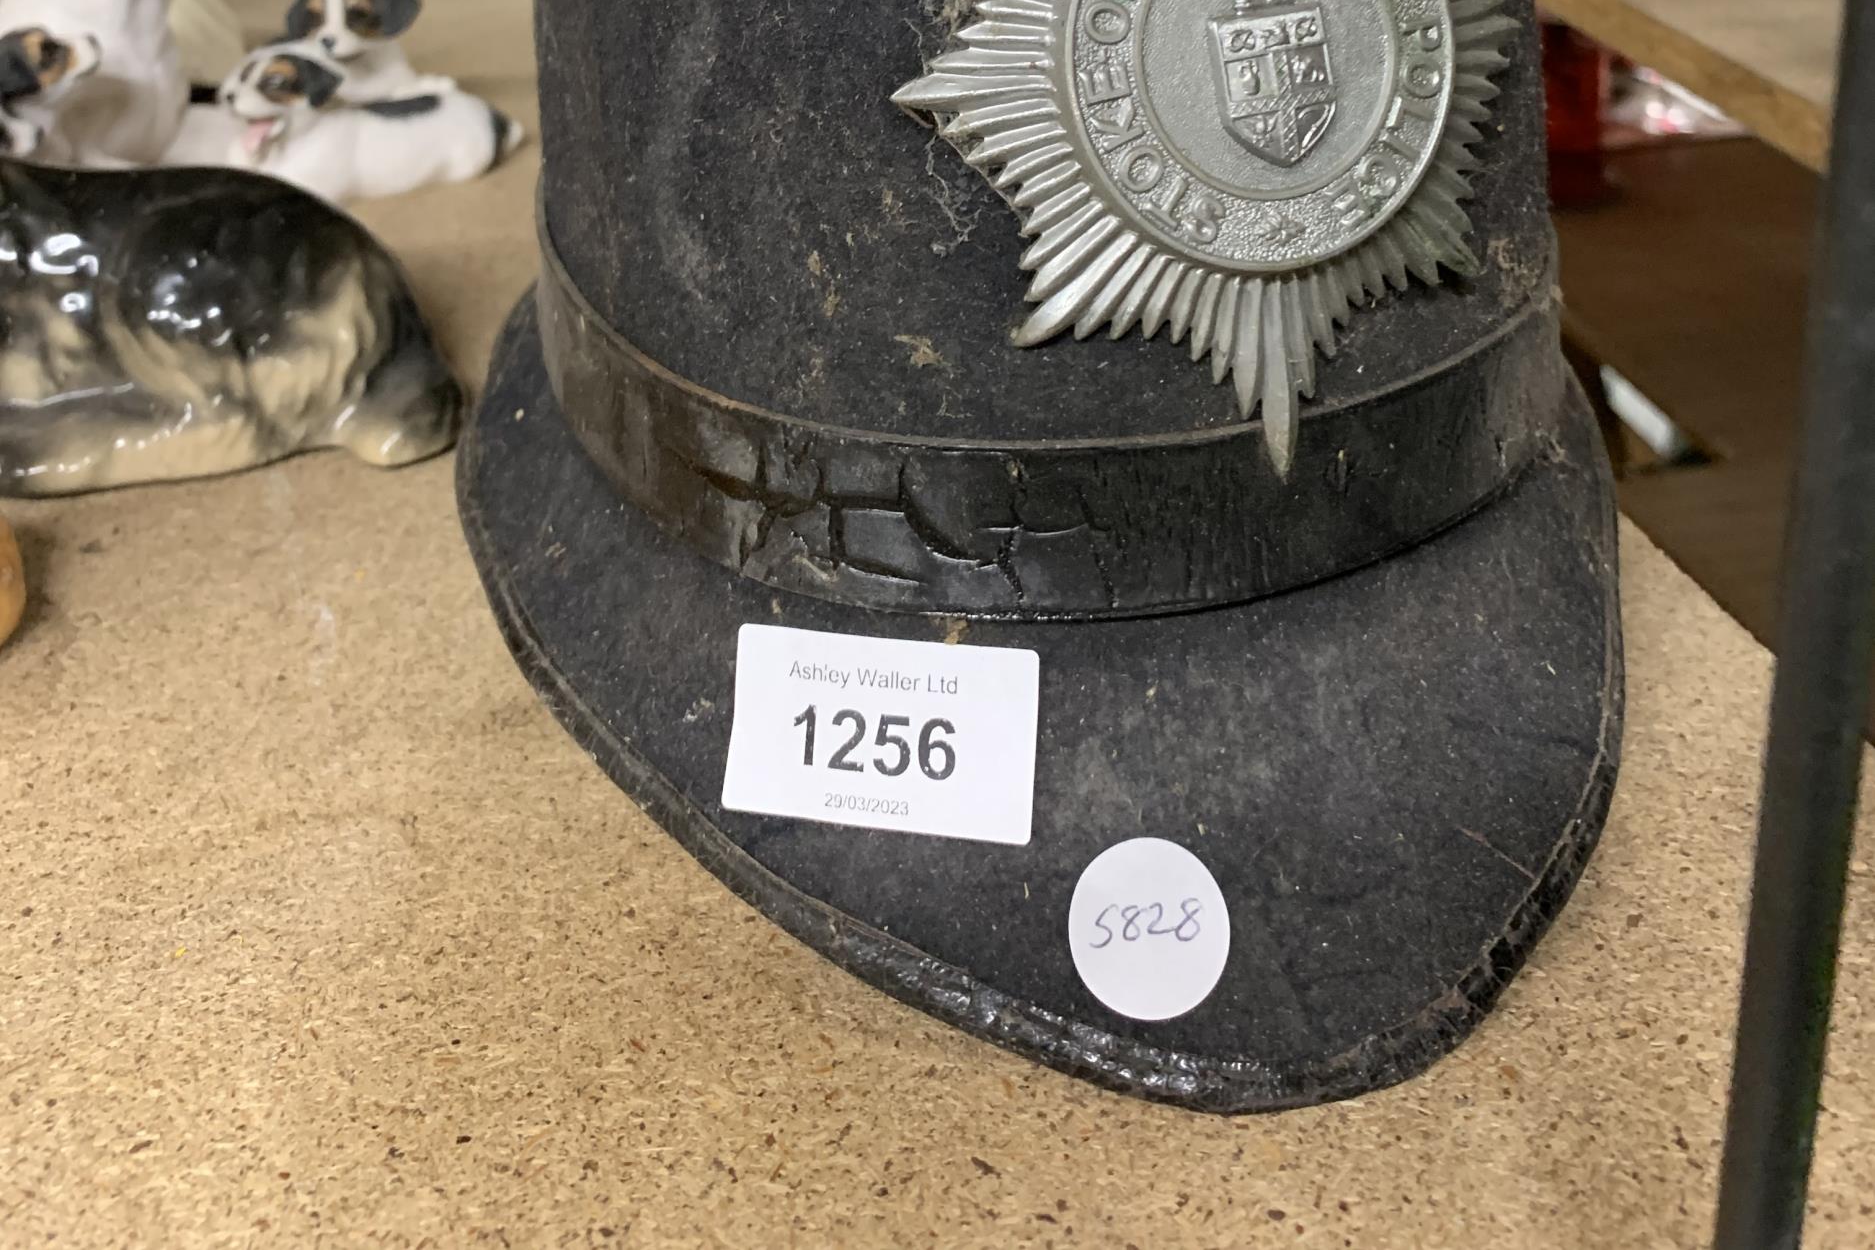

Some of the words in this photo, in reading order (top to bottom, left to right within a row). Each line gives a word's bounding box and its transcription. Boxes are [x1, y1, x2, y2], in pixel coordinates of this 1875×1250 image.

[1326, 15, 1443, 228] POLICE
[789, 660, 850, 689] Ashley
[857, 667, 920, 693] Waller
[927, 673, 958, 695] Ltd
[793, 704, 956, 780] 1256
[824, 792, 909, 817] 29/03/2023
